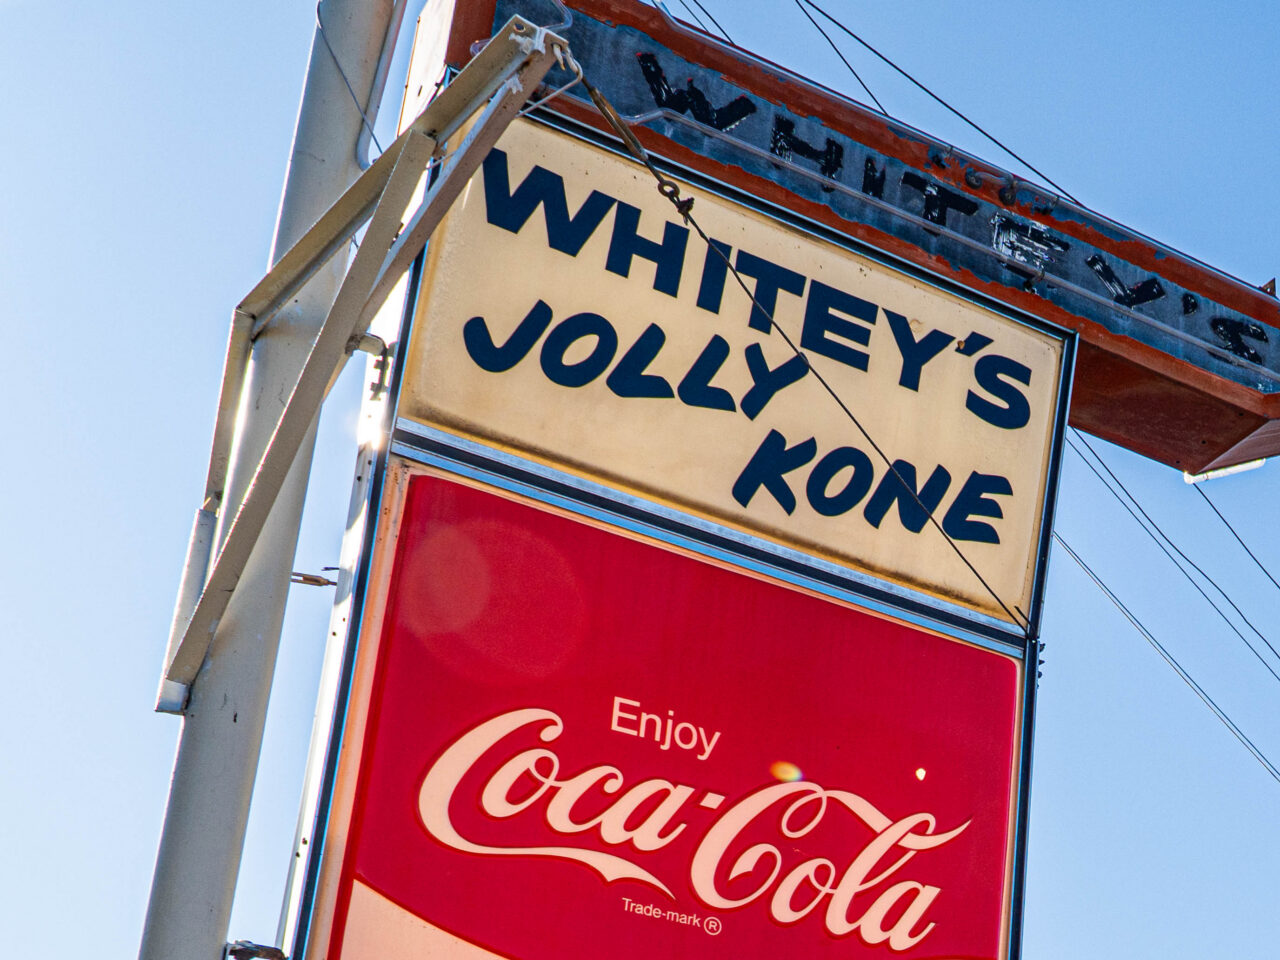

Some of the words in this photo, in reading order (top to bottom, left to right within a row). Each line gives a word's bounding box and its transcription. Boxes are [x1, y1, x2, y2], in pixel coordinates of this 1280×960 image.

[482, 146, 1033, 431] WHITEY'S
[462, 299, 810, 421] JOLLY
[731, 428, 1014, 546] KONE
[610, 696, 721, 760] Enjoy
[418, 707, 973, 952] Coca-Cola
[621, 897, 701, 928] Trade-mark
